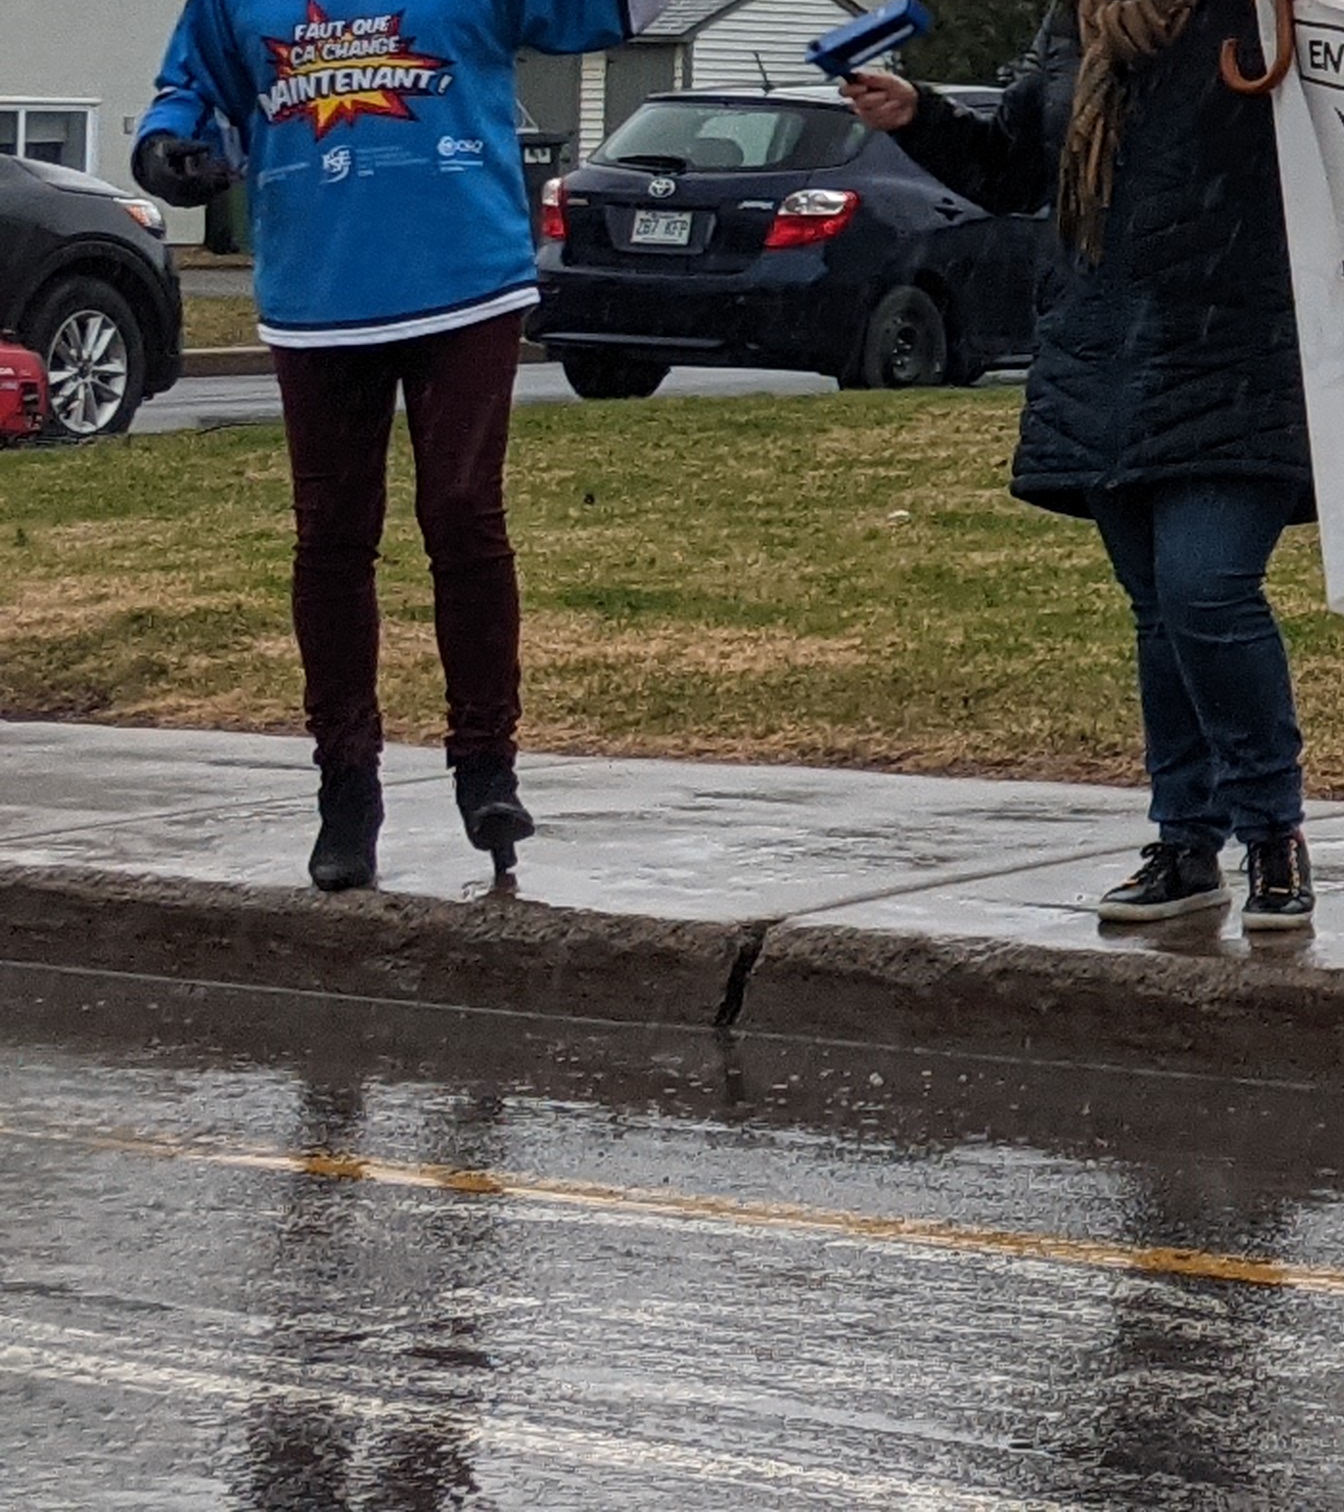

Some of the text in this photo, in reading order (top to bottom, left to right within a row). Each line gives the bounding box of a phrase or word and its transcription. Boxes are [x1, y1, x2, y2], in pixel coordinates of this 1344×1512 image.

[294, 14, 393, 41] FAUT QUE
[321, 36, 401, 60] CHANGE
